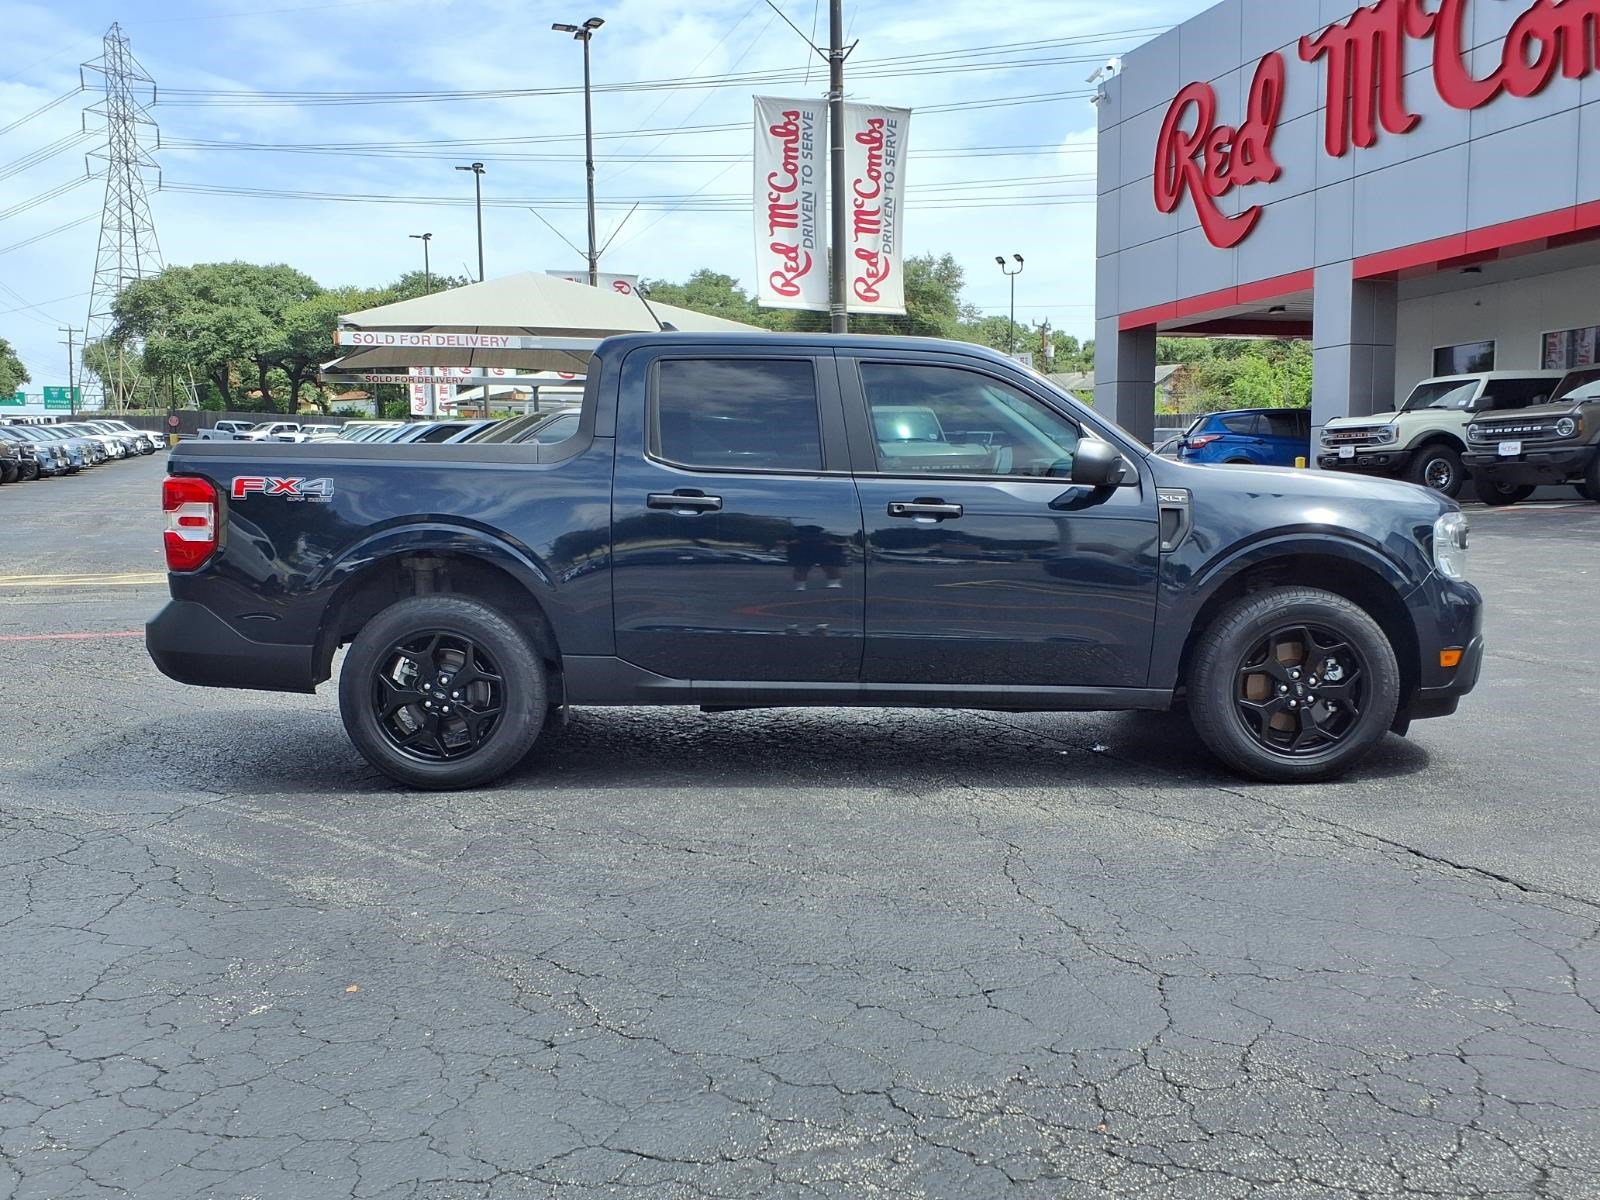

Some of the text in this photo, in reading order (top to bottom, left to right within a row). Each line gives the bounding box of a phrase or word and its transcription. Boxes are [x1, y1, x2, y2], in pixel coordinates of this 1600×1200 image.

[767, 109, 813, 297] Red McCombs
[801, 110, 815, 250] DRIVEN TO SERVE
[853, 117, 891, 303] Red McCombs
[882, 118, 898, 255] DRIVEN TO SERVE
[1154, 51, 1285, 249] Red
[352, 333, 510, 347] SOLD FOR DELIVERY
[365, 375, 465, 384] SOLD FOR DELIVERY
[231, 476, 334, 500] FX4
